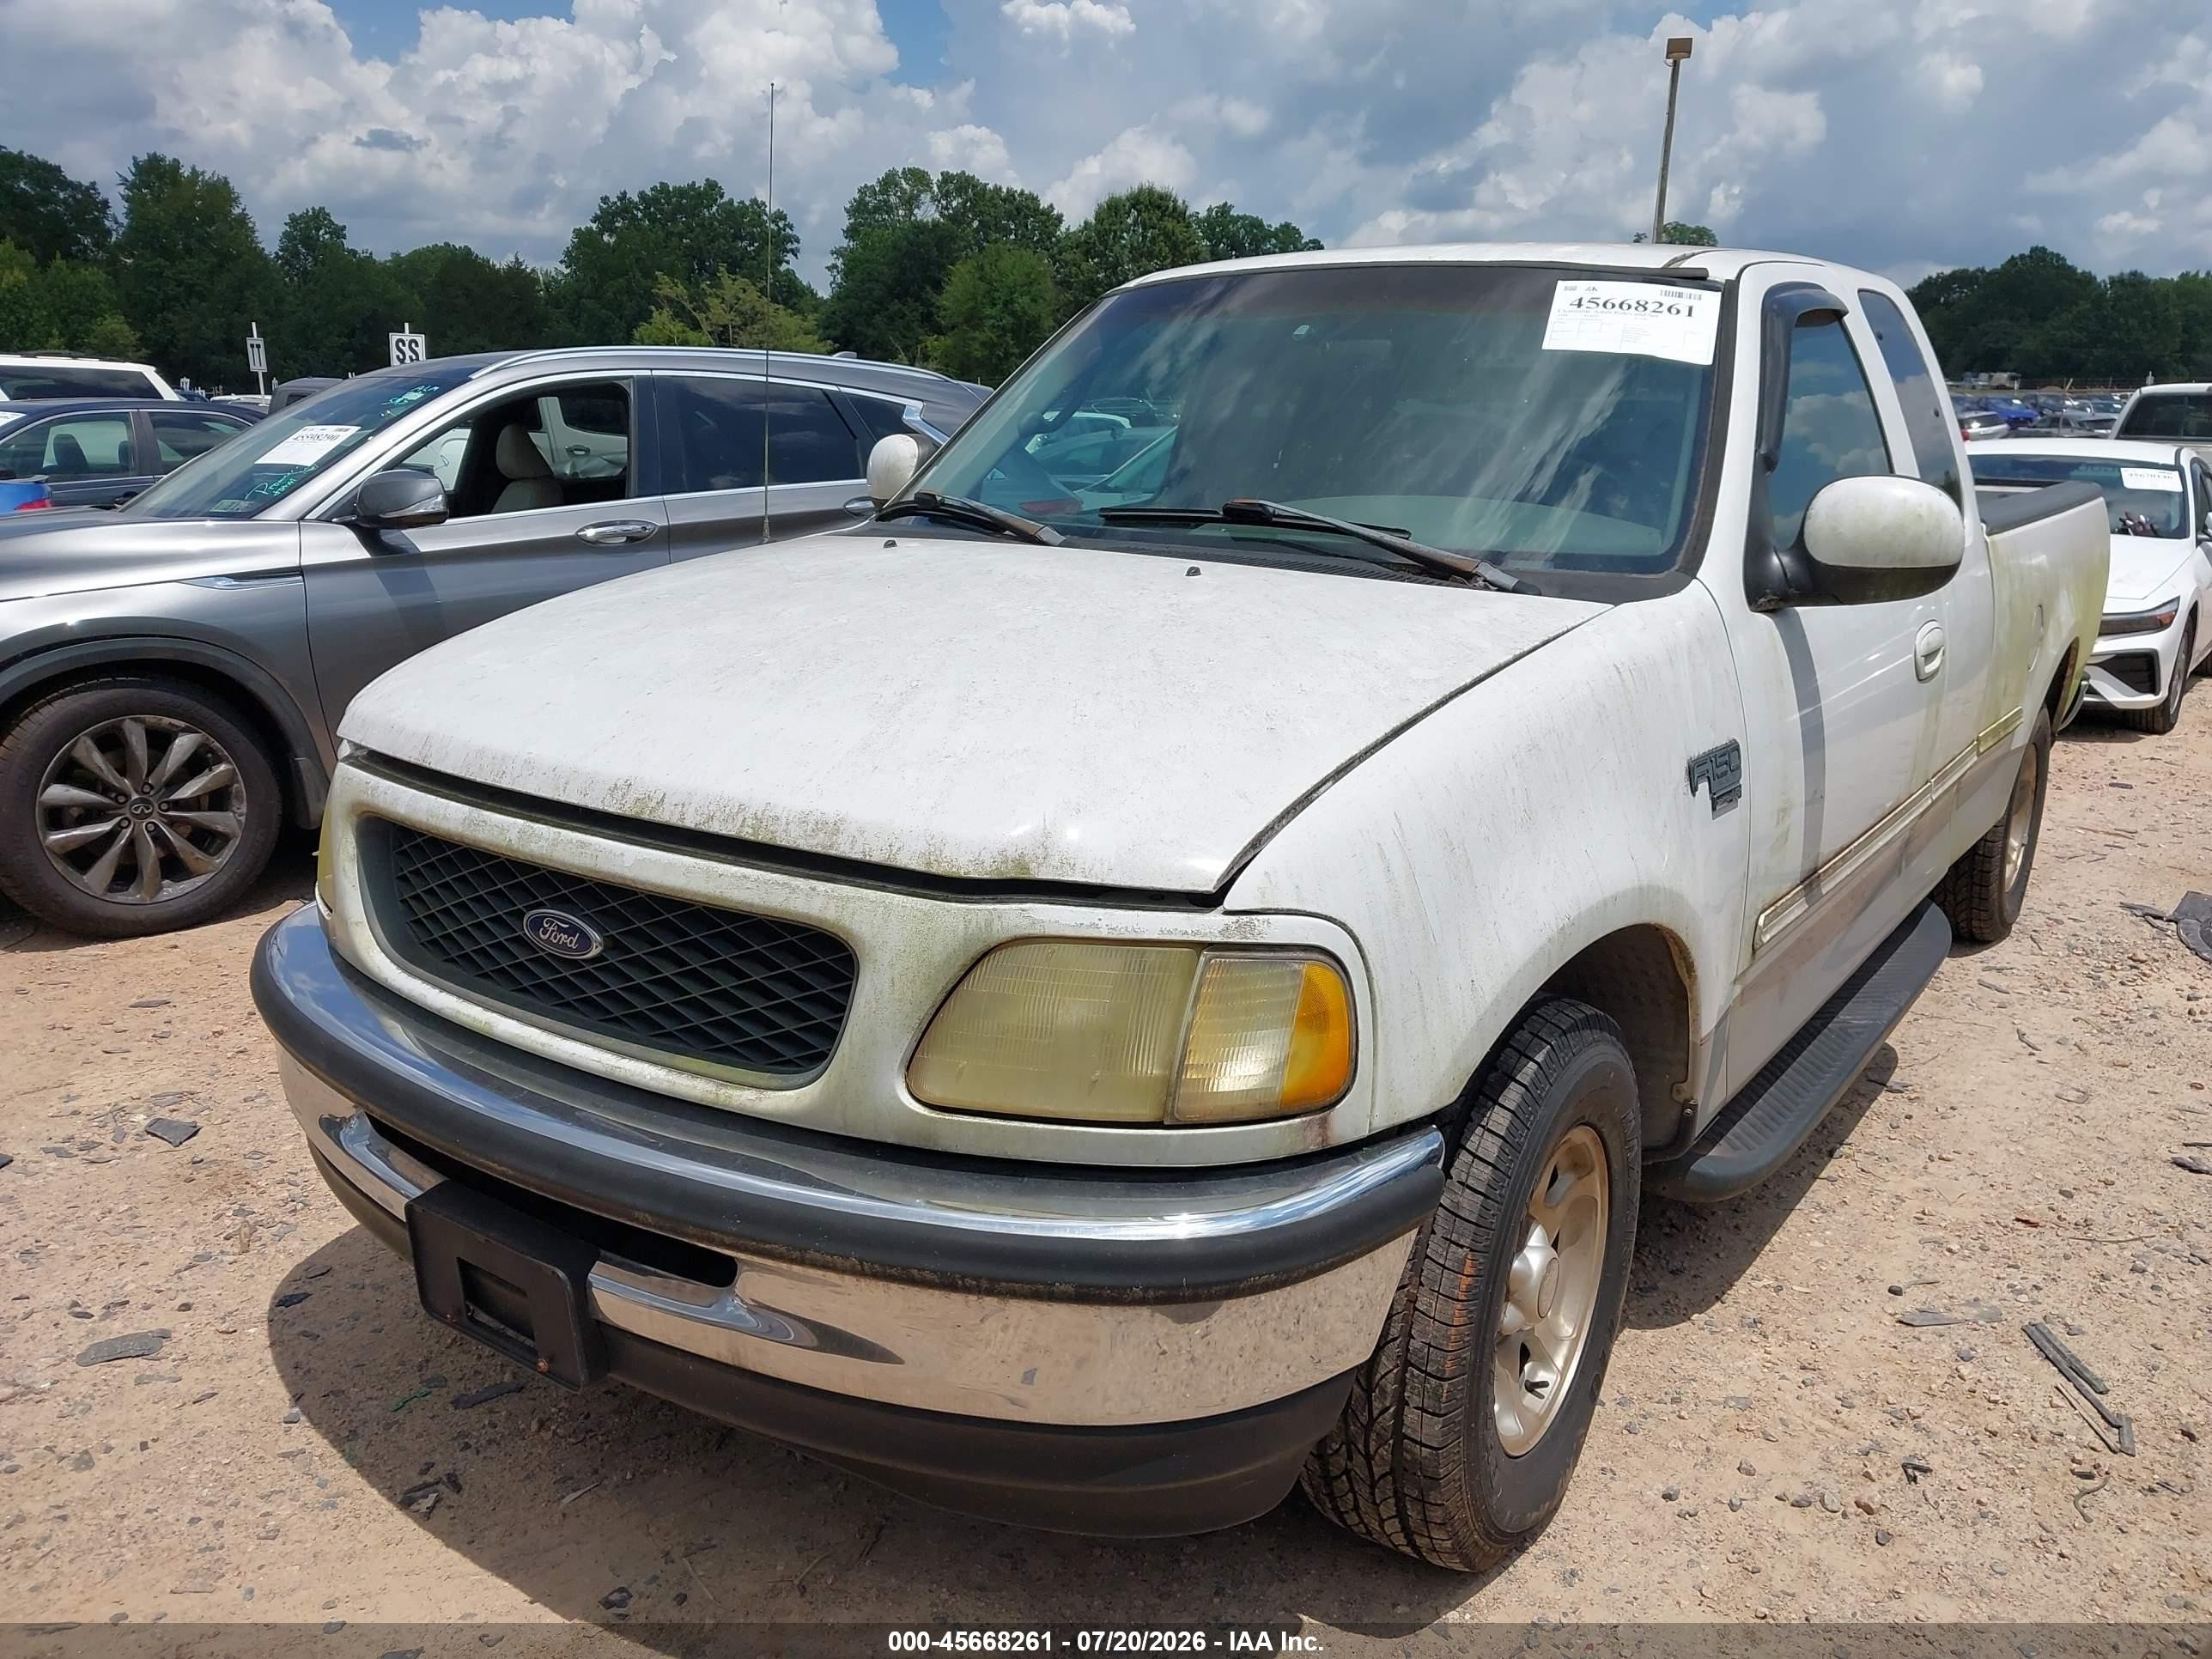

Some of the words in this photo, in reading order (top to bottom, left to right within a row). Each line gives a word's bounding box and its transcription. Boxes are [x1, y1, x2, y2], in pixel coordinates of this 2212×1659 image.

[1570, 297, 1694, 317] 45668261
[395, 337, 420, 363] SS
[539, 917, 580, 949] Ford
